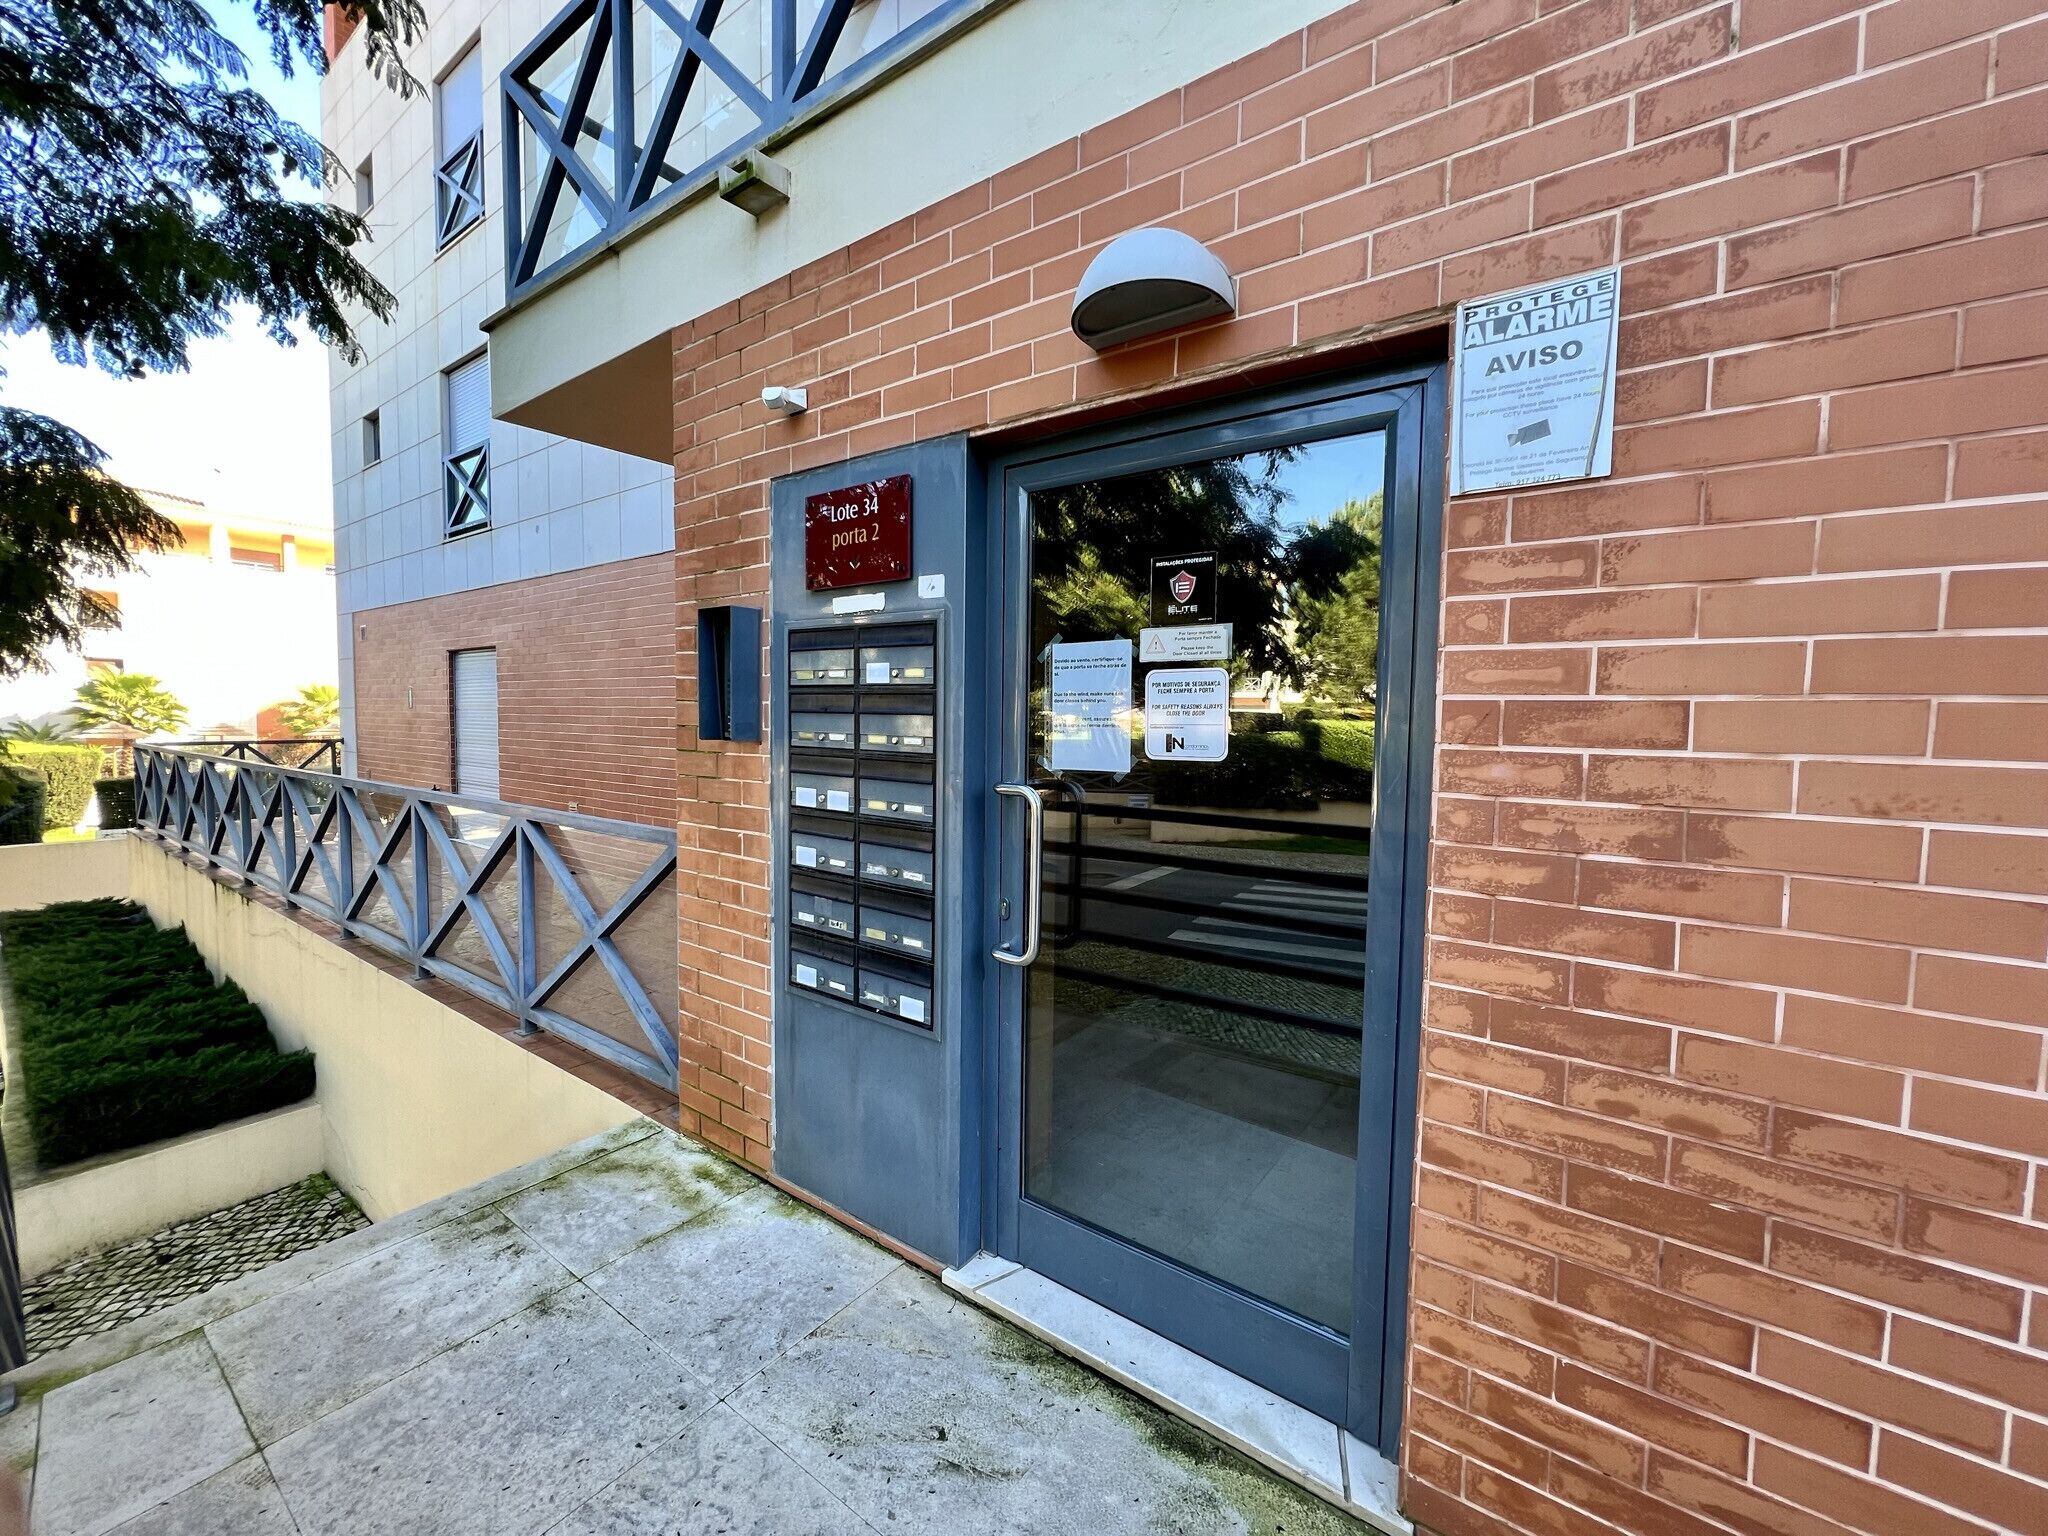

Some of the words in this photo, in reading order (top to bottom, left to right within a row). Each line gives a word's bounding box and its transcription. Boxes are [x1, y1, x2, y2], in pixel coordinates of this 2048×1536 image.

[1465, 278, 1612, 323] PROTEGE
[1464, 293, 1614, 348] ALARME
[1485, 340, 1584, 377] AVISO
[831, 504, 859, 523] Lote
[863, 496, 879, 516] 34
[832, 527, 868, 551] porta
[872, 523, 880, 541] 2
[1191, 680, 1222, 688] SEGURANÇA
